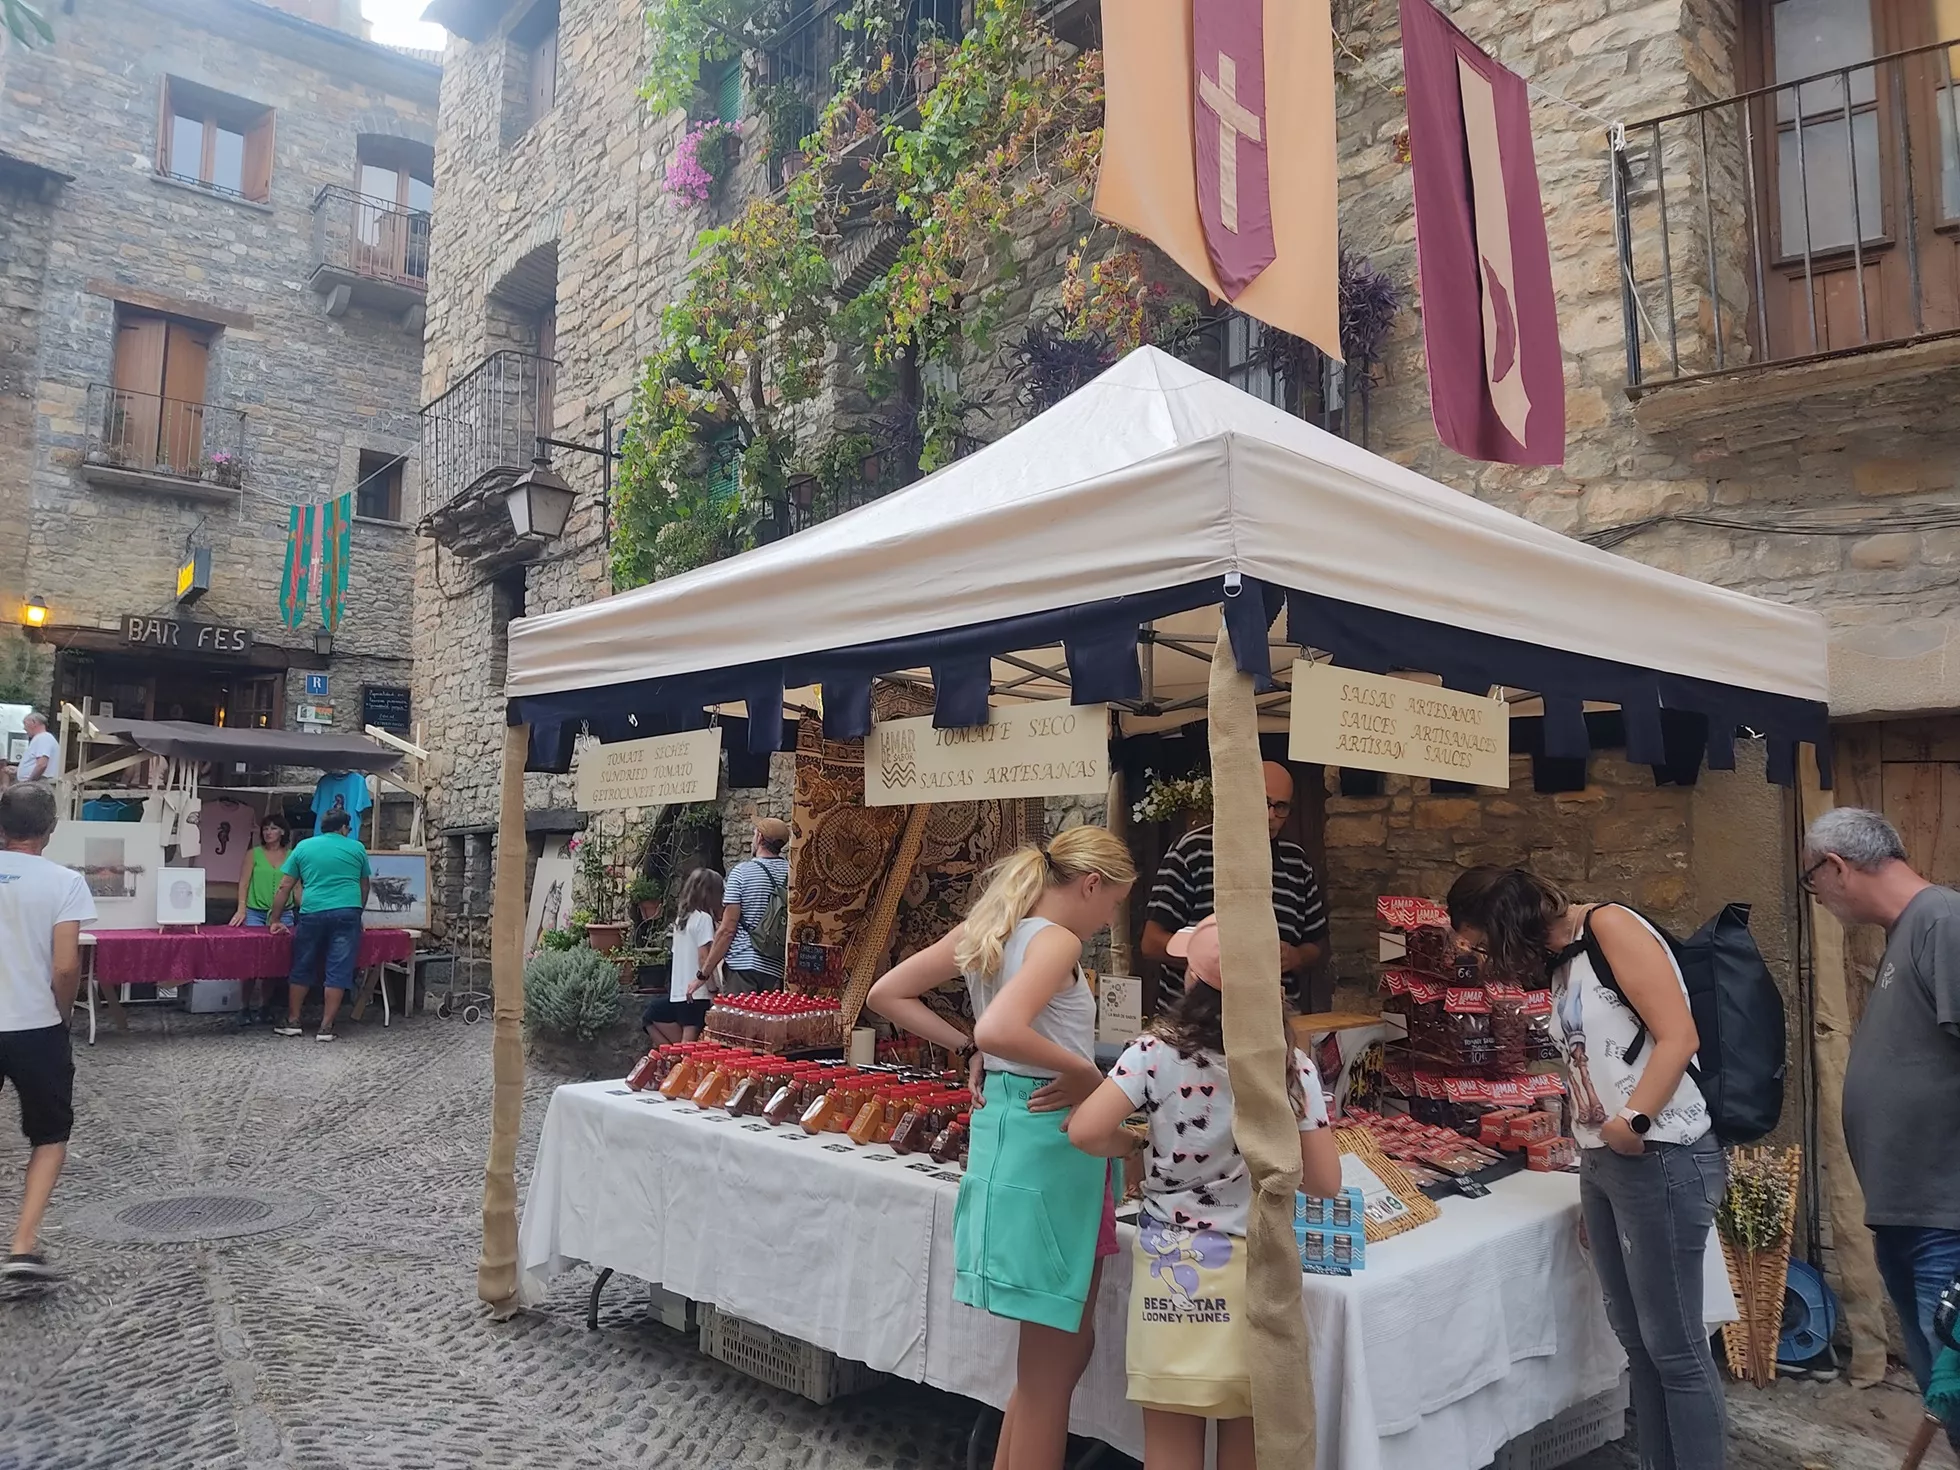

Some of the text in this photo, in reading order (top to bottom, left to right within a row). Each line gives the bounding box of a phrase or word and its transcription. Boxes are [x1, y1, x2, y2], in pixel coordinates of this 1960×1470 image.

[128, 617, 246, 651] BAR FES
[312, 676, 322, 688] R
[1339, 684, 1483, 726] SALSAS ARTESANAS
[934, 713, 1076, 747] TOMATE SECO
[1339, 710, 1498, 754] SAUCES ARTISANALES
[606, 749, 644, 766] TOMATE
[1336, 733, 1474, 769] ARTISAN SAUCES
[600, 762, 694, 783] SUNDRIED TOMATO
[918, 758, 1098, 790] SALSAS ARTESANAS
[658, 780, 698, 796] TOMATE
[1457, 968, 1472, 979] 6€
[1183, 1298, 1226, 1312] TAR
[1142, 1312, 1231, 1323] LOONEY TUNES
